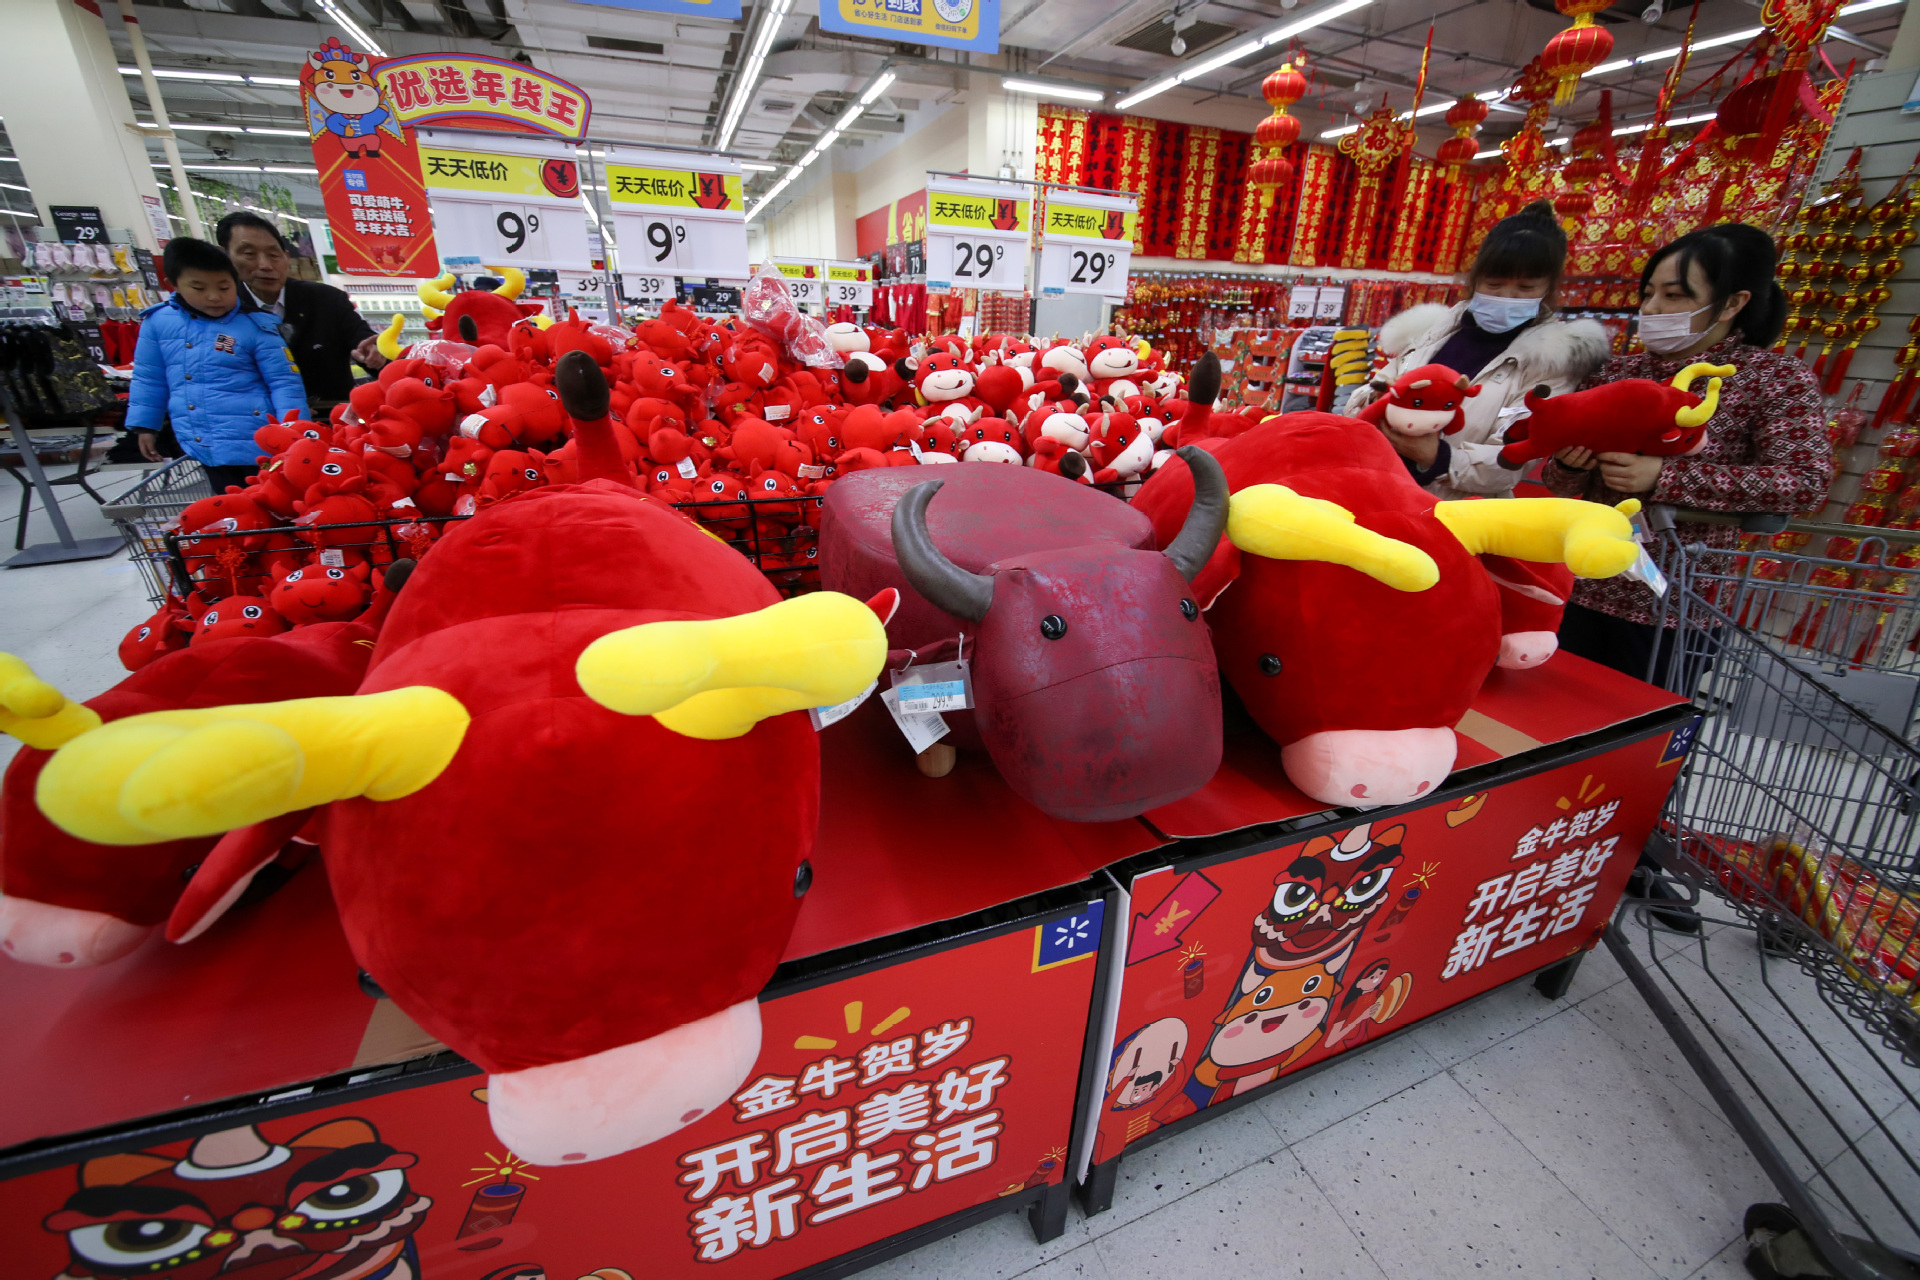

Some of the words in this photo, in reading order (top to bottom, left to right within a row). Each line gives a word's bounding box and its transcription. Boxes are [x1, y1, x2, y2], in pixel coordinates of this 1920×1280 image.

[386, 65, 579, 129] 优选年货王
[427, 156, 508, 182] 天天低价
[616, 175, 684, 198] 天天低价
[935, 201, 986, 220] 天天低价
[1051, 212, 1097, 230] 天天低价
[831, 270, 853, 278] 天天低价
[1511, 797, 1621, 862] 金牛贺岁
[1463, 835, 1616, 923] 开启美好
[1441, 881, 1599, 981] 新生活
[736, 1018, 973, 1121] 金牛贺岁
[681, 1057, 1009, 1201] 开启美好
[692, 1111, 1003, 1263] 新生活
